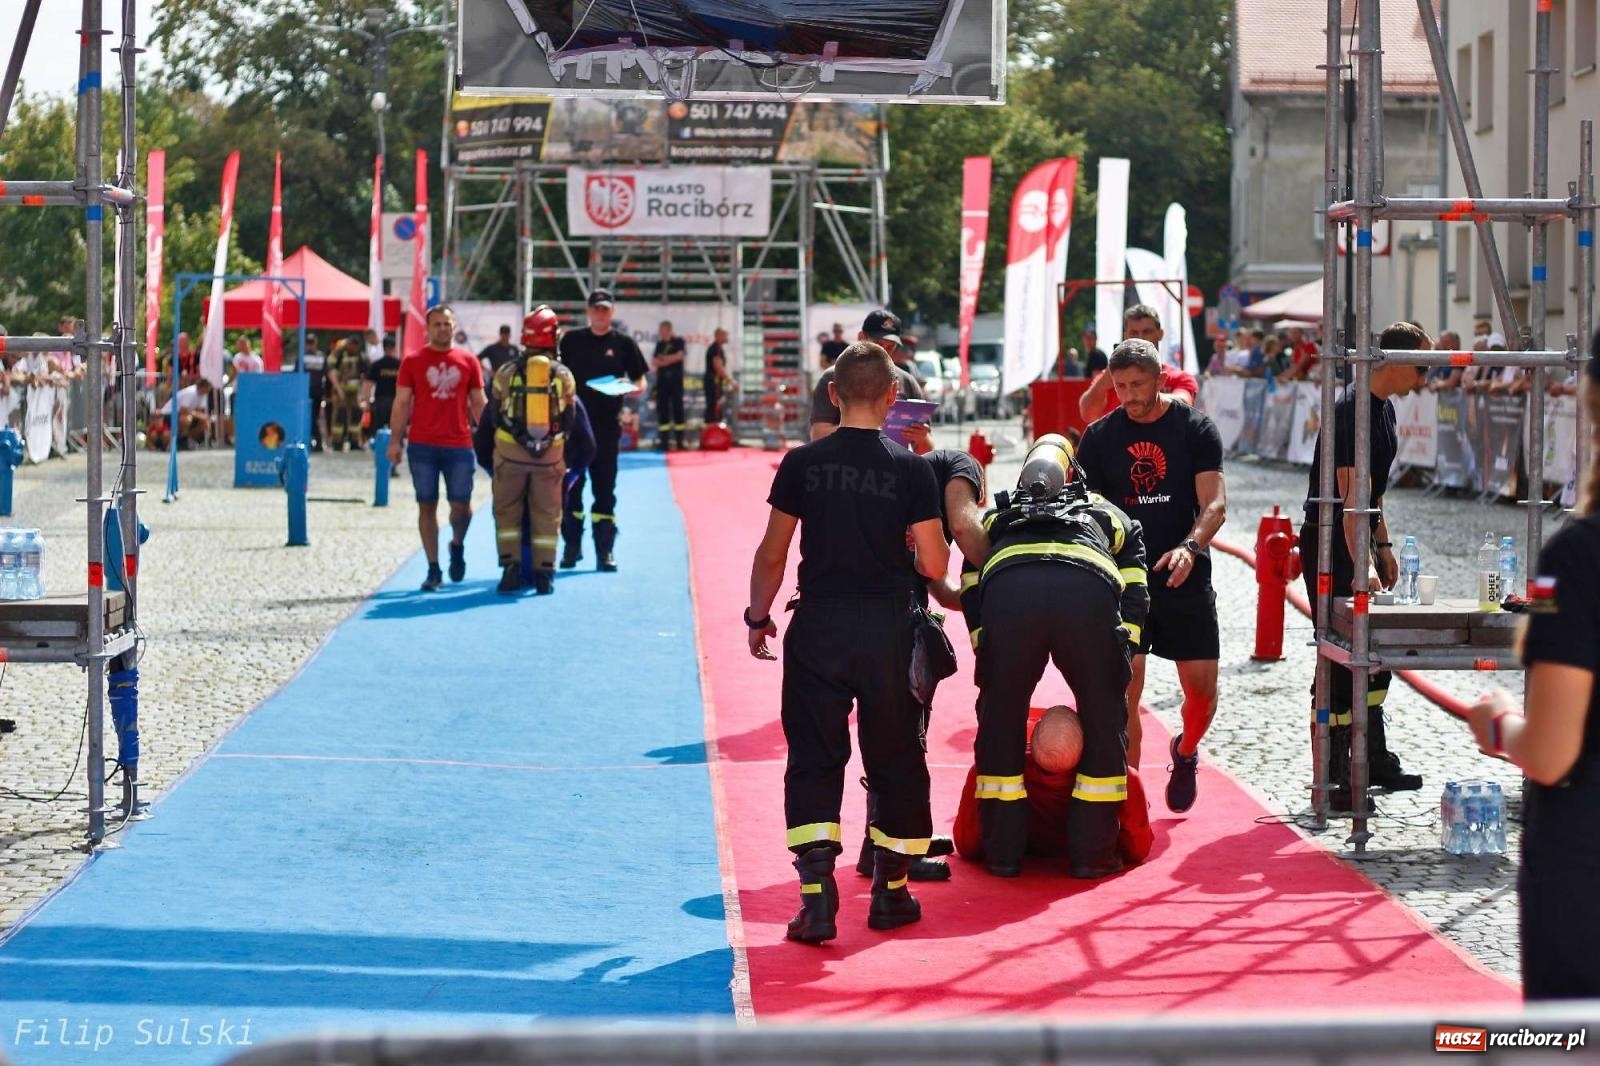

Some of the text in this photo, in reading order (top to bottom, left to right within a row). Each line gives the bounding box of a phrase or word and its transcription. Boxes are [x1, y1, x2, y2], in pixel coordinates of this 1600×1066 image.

[690, 103, 787, 119] 501 747 994
[513, 116, 543, 132] 994
[647, 184, 705, 195] MIASTO
[647, 197, 753, 218] Racibórz
[1488, 572, 1496, 602] OSHEE
